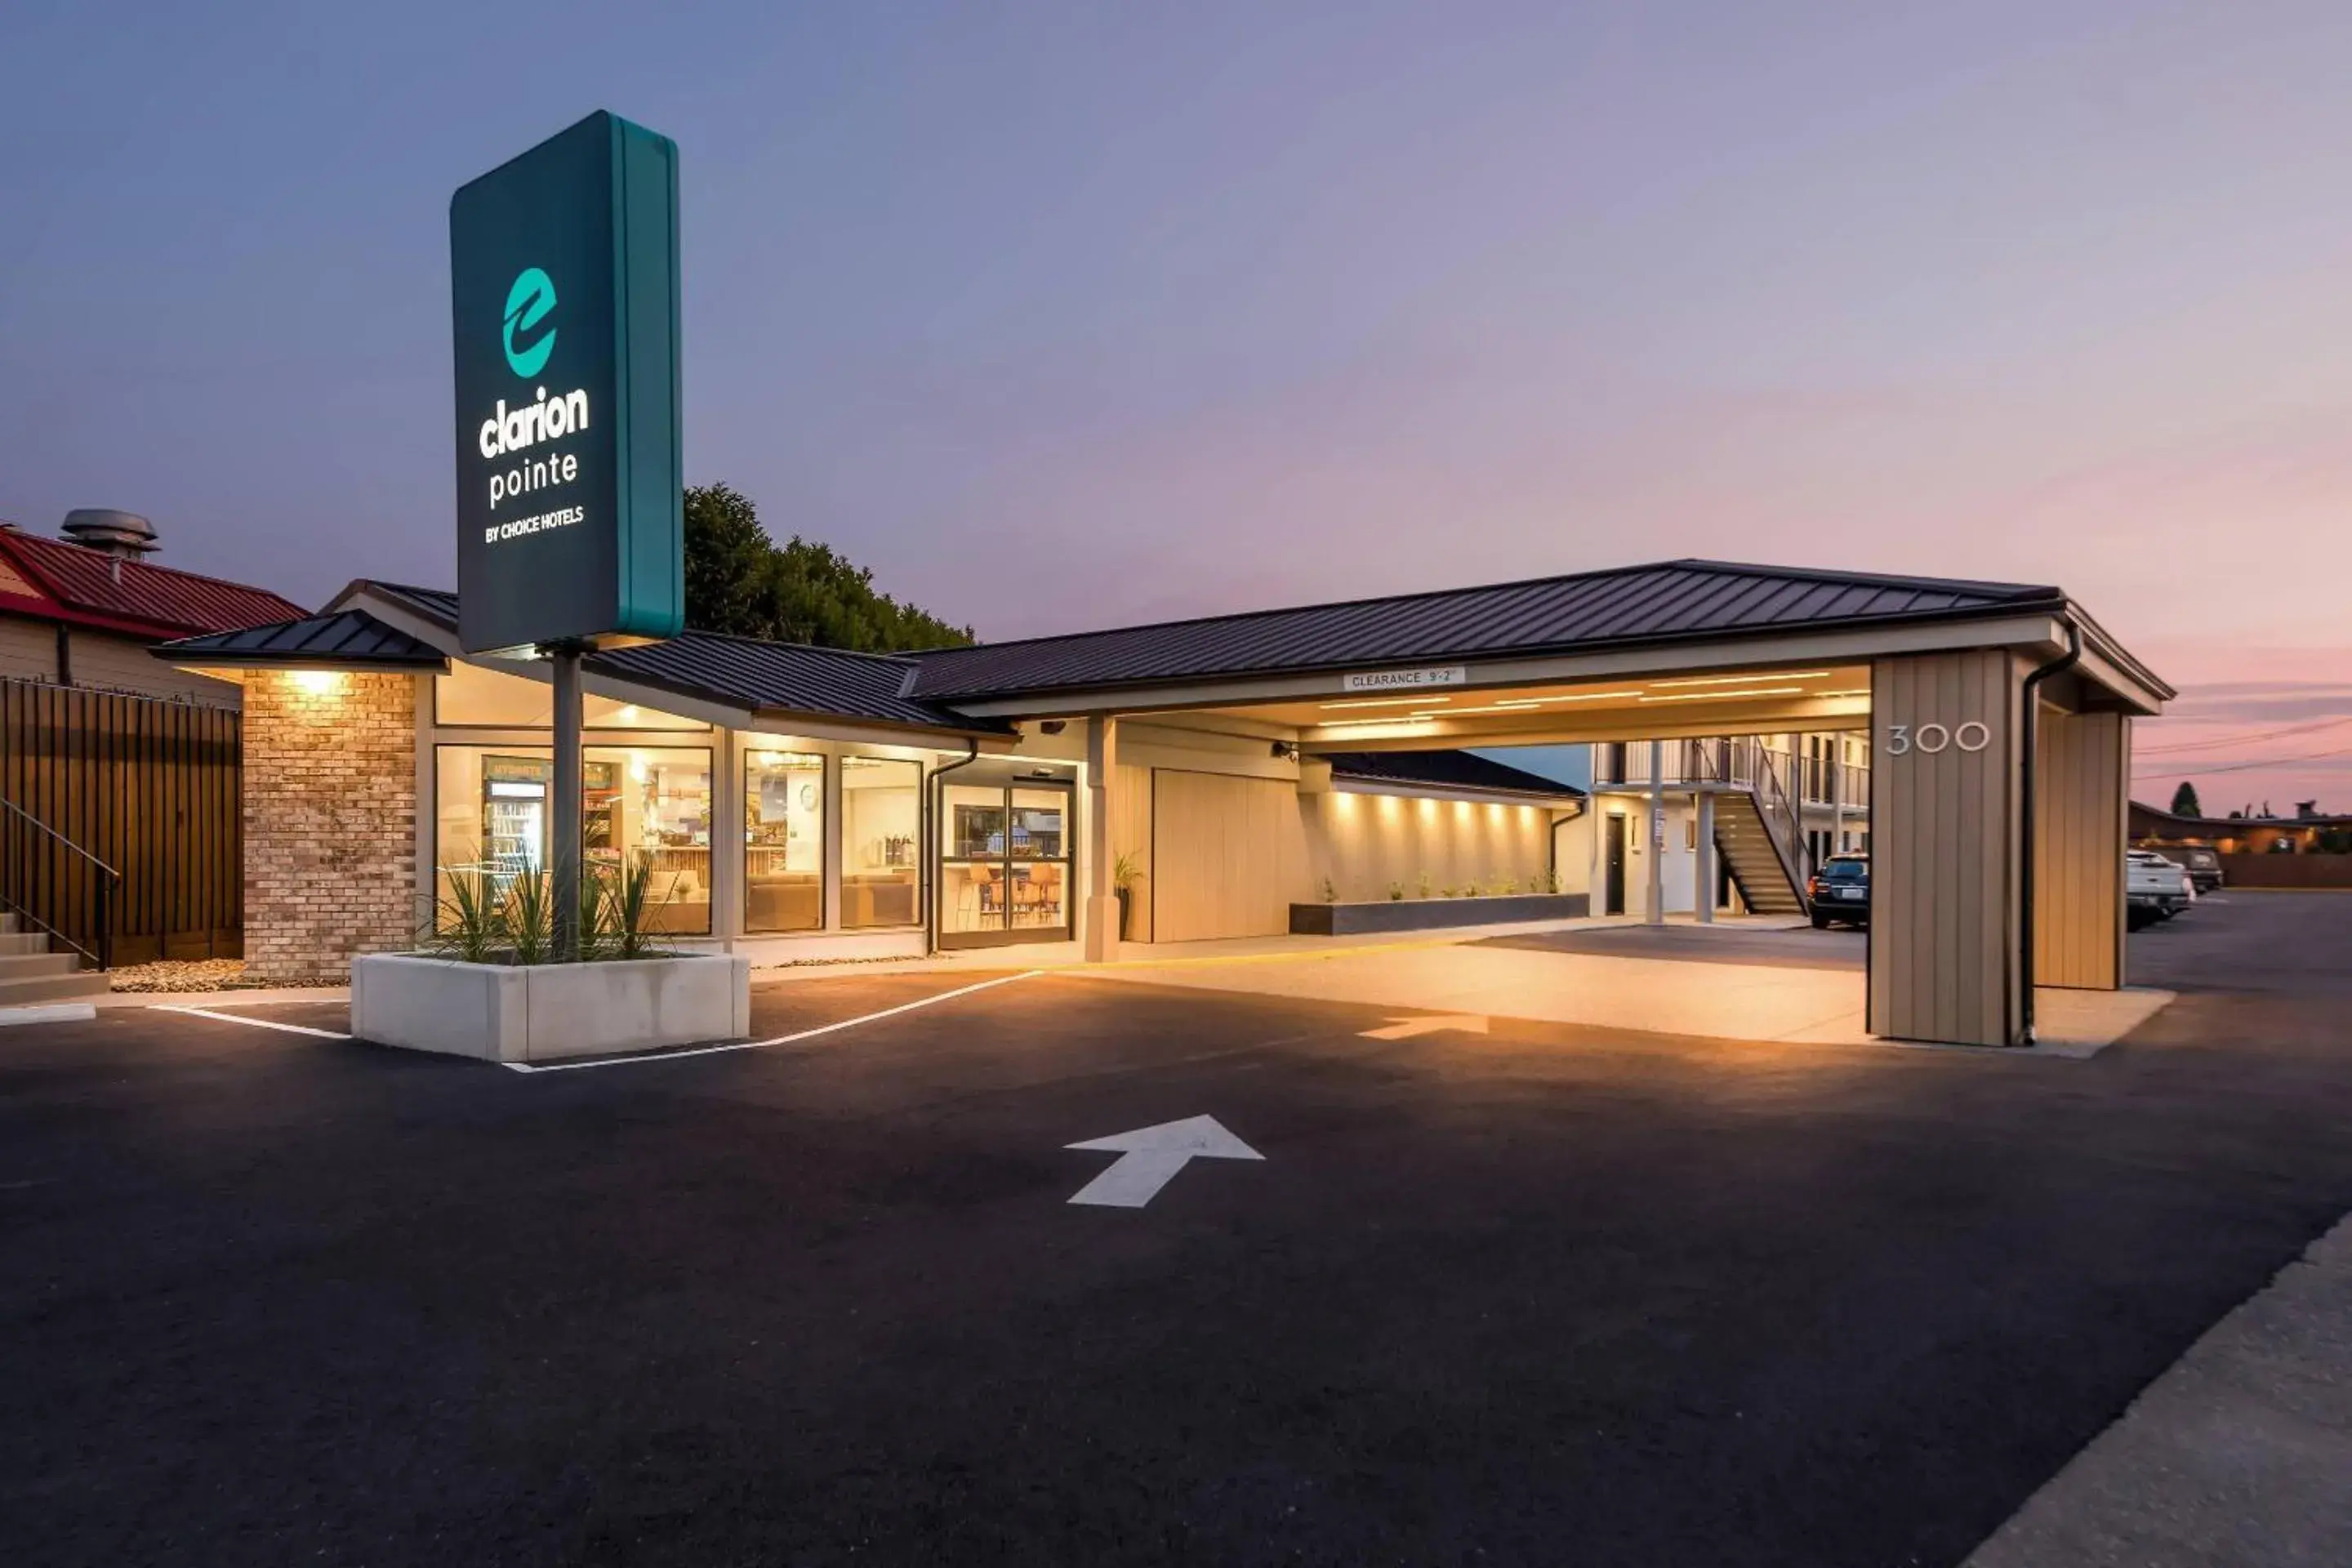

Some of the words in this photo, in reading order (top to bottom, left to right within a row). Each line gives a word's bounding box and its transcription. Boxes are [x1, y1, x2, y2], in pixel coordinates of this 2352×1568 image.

[480, 386, 588, 458] clarion
[490, 453, 577, 509] pointe
[486, 527, 499, 542] BY
[501, 516, 540, 539] CHOICE
[541, 506, 584, 529] HOTELS
[1352, 672, 1420, 687] CLEARANCE
[1885, 721, 1989, 755] 300
